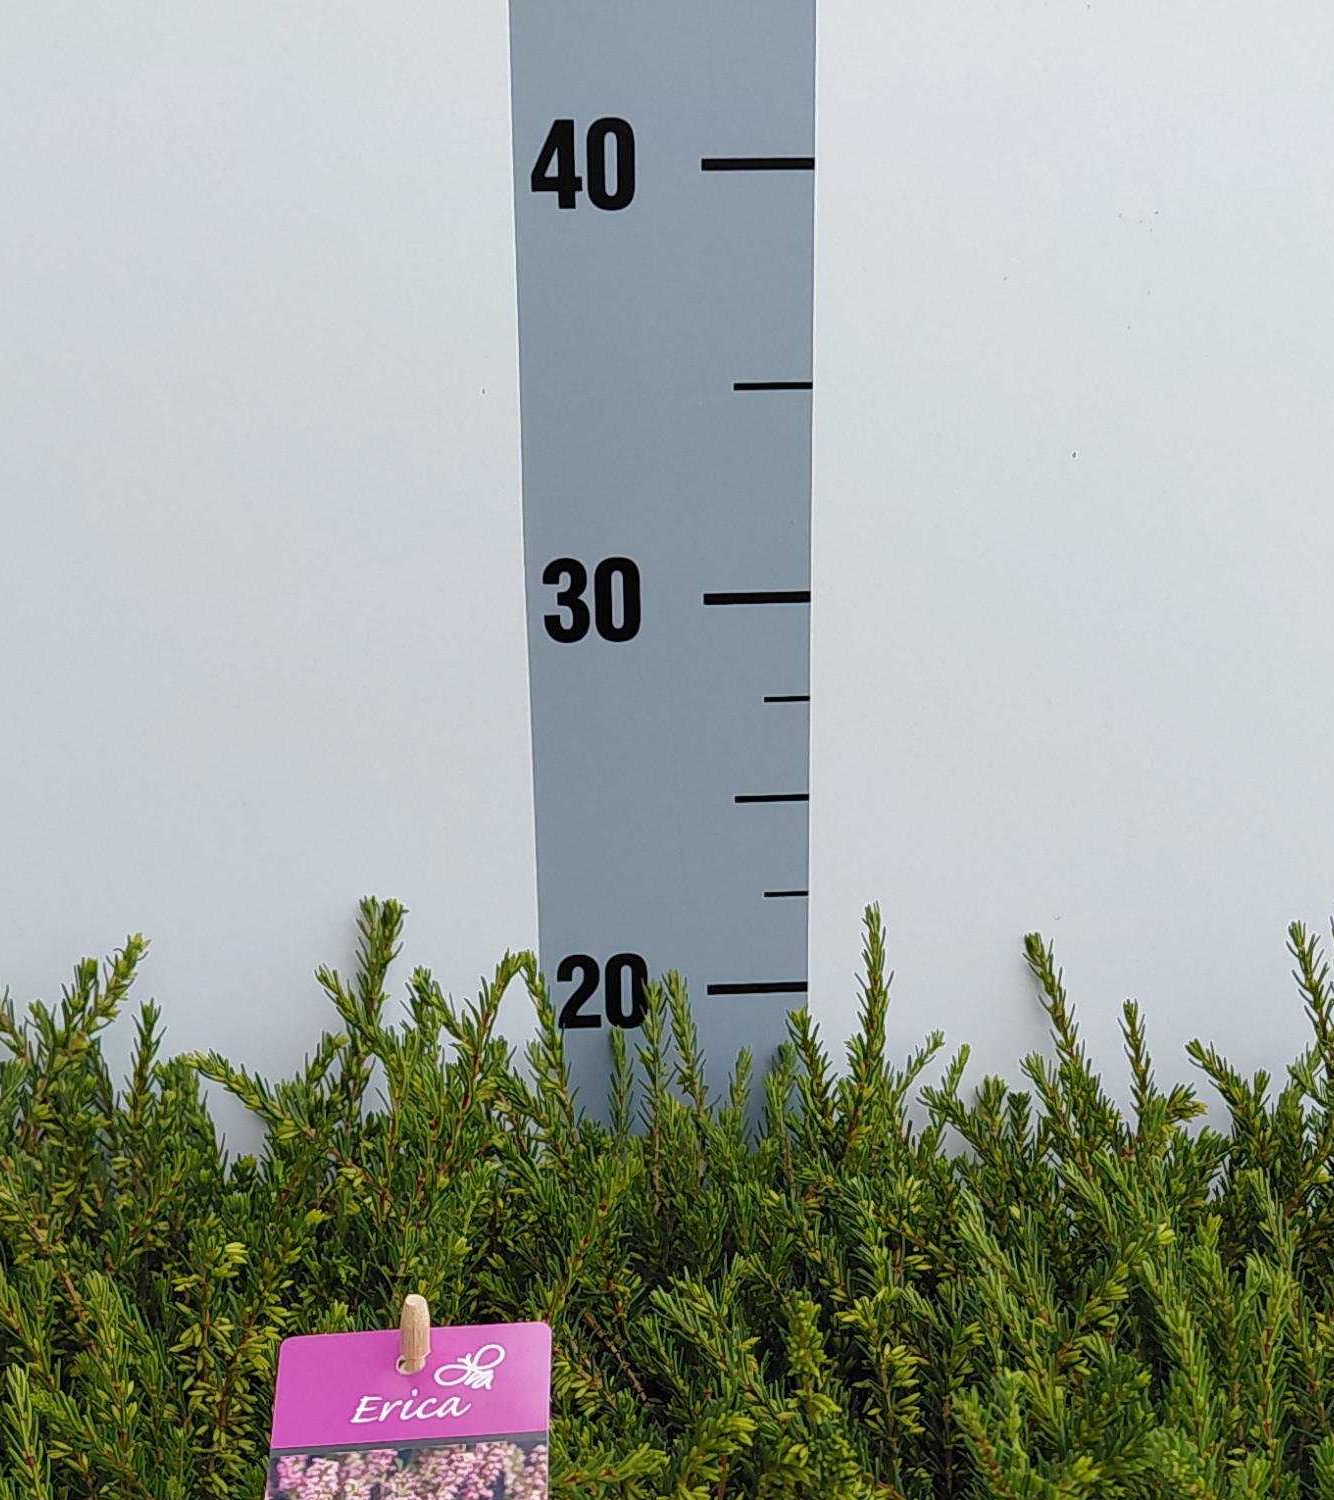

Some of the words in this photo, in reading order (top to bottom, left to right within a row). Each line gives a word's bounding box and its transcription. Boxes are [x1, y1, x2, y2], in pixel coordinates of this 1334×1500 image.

[530, 116, 636, 211] 40
[542, 556, 642, 644] 30
[556, 952, 649, 1029] 20
[349, 1388, 473, 1425] Erica
